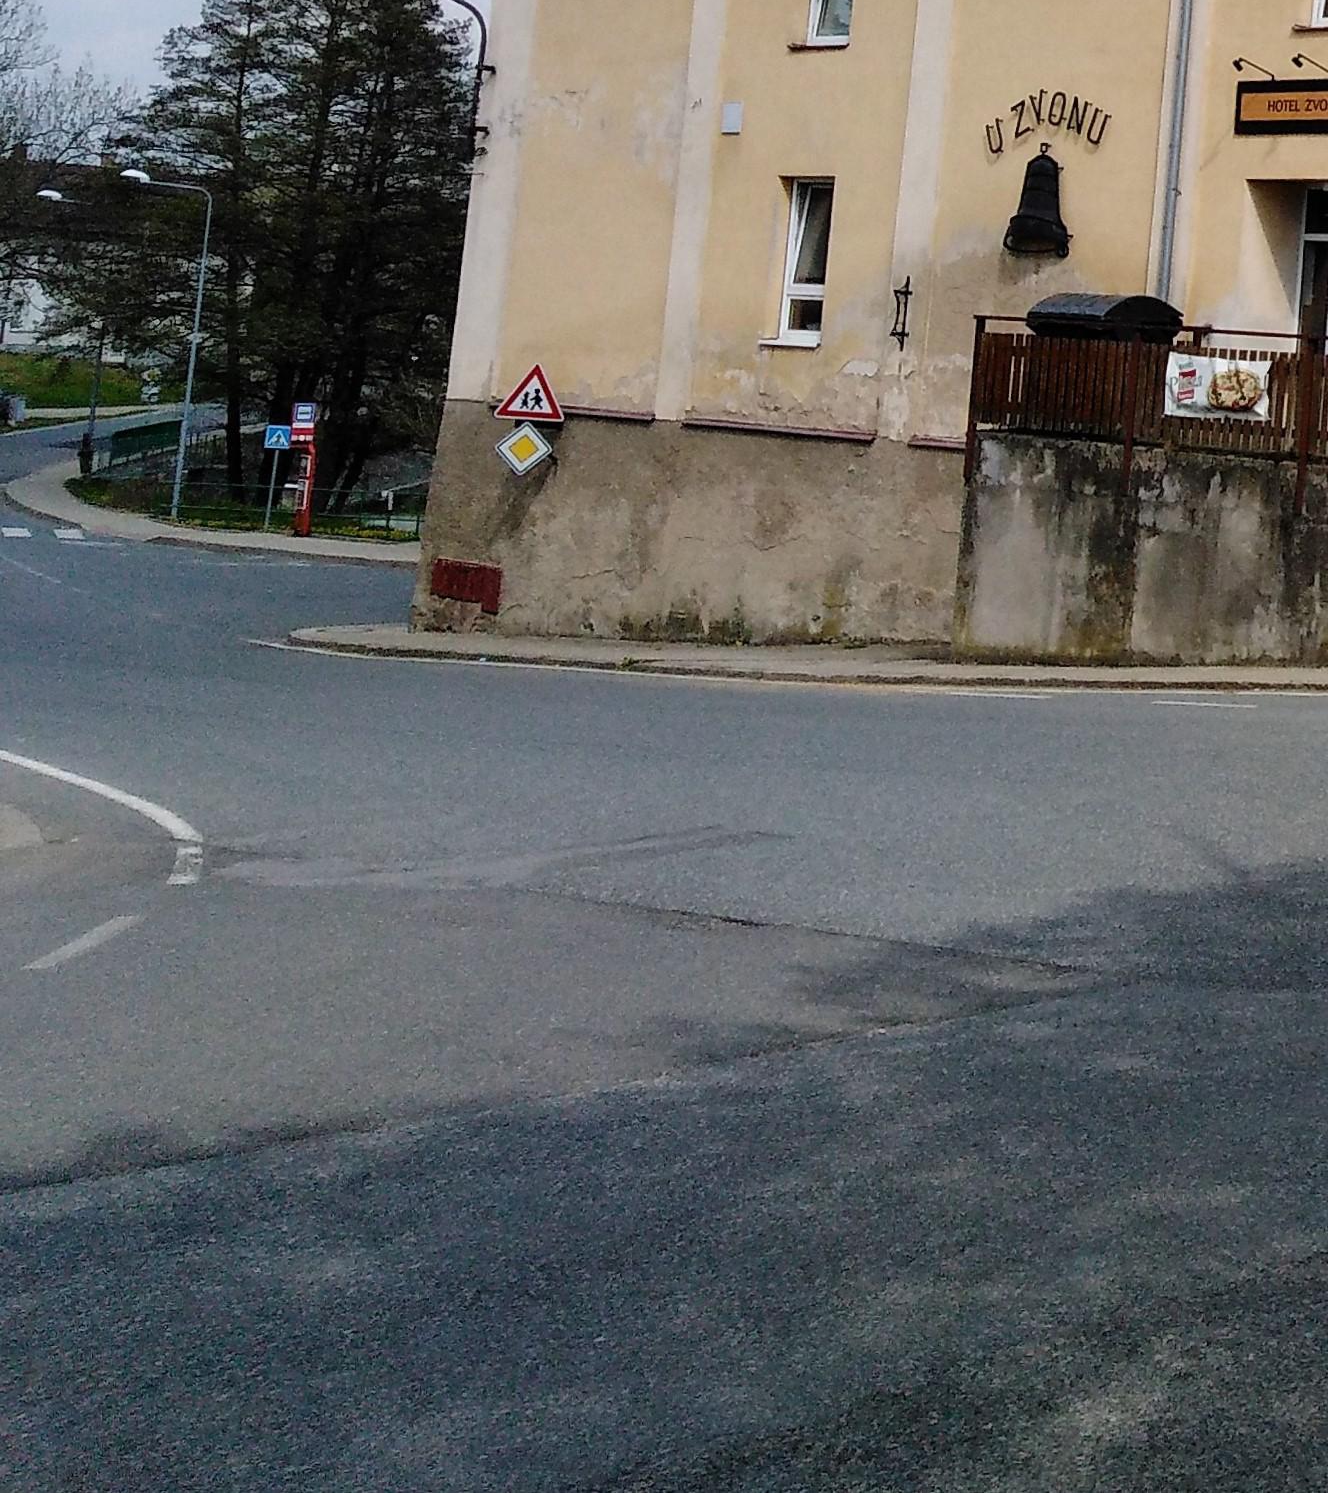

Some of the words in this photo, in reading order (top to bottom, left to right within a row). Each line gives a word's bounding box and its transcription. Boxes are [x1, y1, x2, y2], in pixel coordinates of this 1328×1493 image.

[985, 118, 1004, 154] U
[1010, 88, 1112, 145] ZVONU
[1268, 100, 1300, 113] HOTEL
